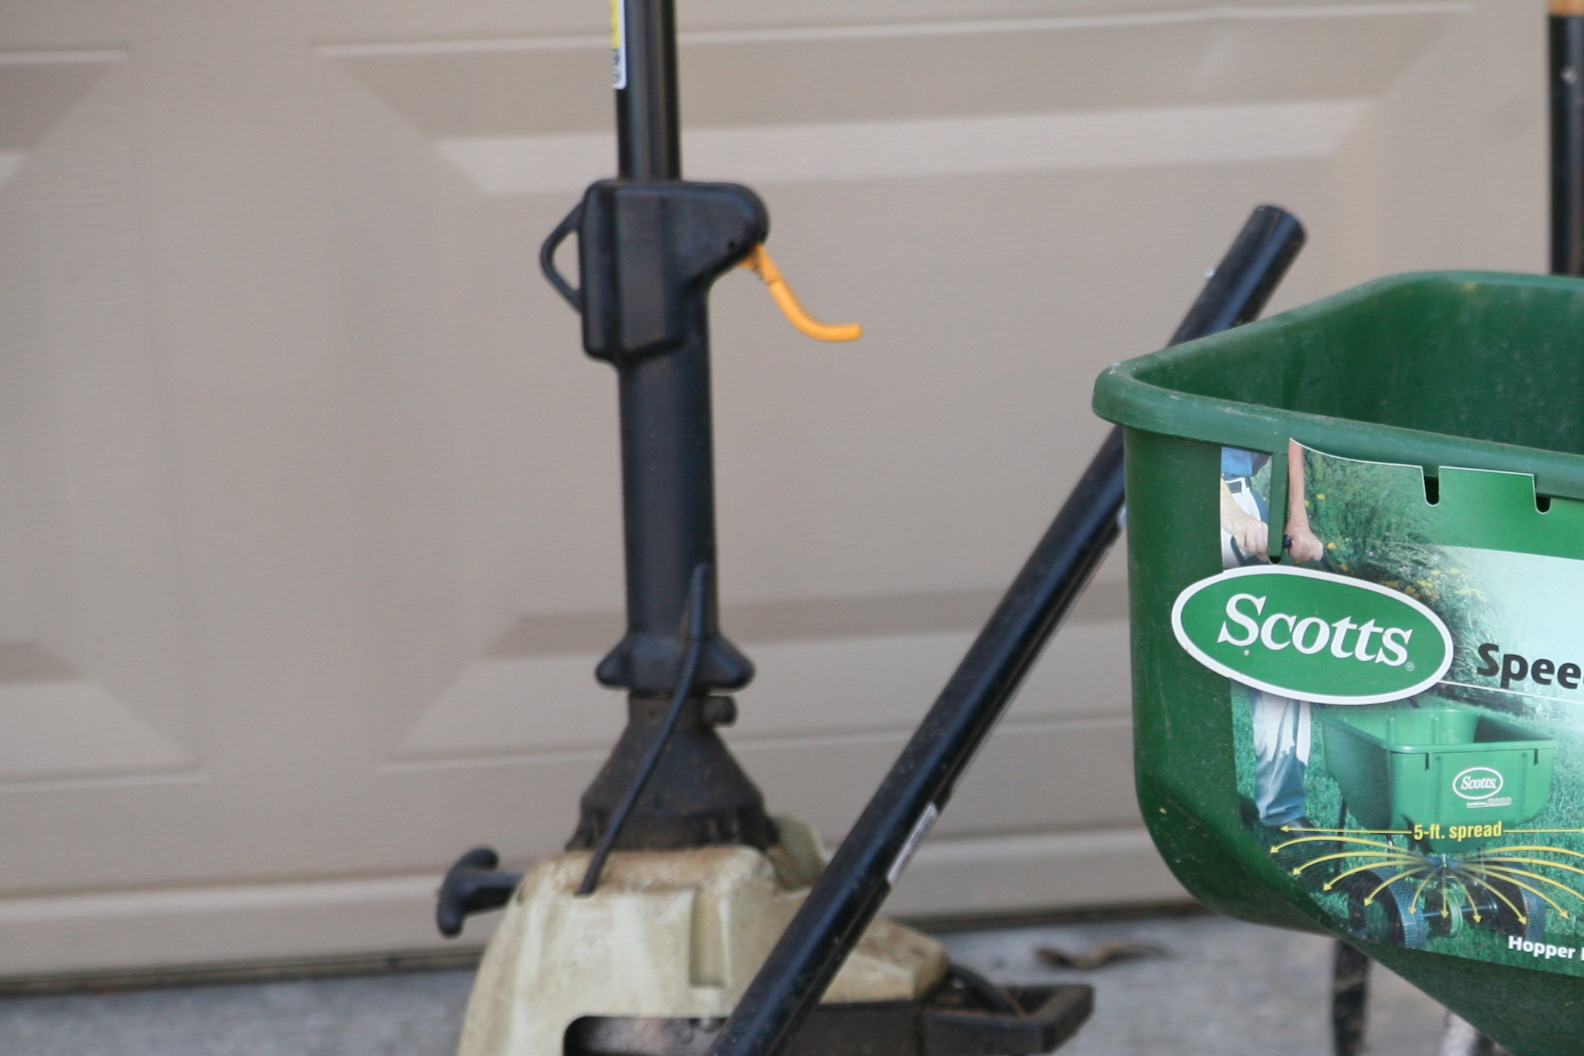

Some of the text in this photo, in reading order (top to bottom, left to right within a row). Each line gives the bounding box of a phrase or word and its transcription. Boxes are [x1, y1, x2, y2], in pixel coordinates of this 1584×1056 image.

[1413, 820, 1503, 842] 5-ft. spread
[1508, 935, 1576, 959] Hopper
